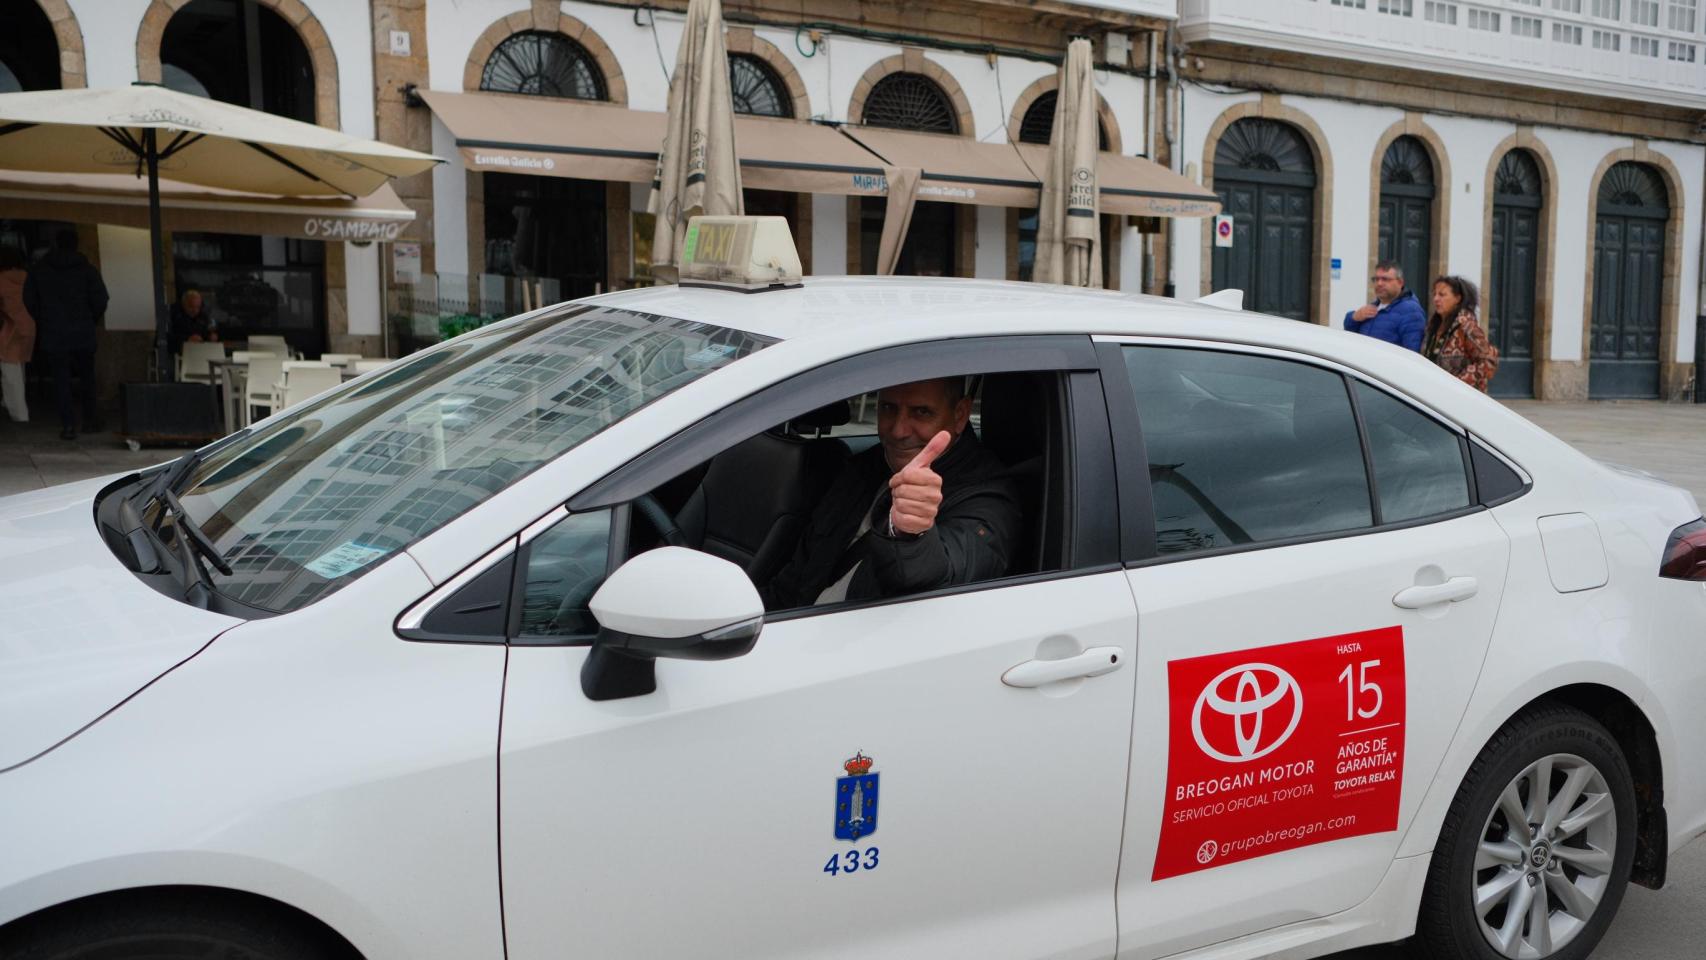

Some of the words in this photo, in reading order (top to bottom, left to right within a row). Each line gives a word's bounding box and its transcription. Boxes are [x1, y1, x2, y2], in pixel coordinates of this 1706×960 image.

[304, 218, 399, 239] O'SAMPAIO
[697, 224, 735, 262] TAXI
[1337, 643, 1362, 655] HASTA
[1338, 659, 1383, 721] 15
[1337, 741, 1370, 760] AÑOS
[1372, 737, 1388, 752] DE
[1175, 771, 1254, 801] BREOGAN
[1259, 759, 1315, 784] MOTOR
[1333, 775, 1367, 791] TOYOTA
[1368, 769, 1396, 784] RELAX
[1172, 802, 1225, 824] SERVICIO
[1227, 793, 1269, 812] OFICIAL
[1272, 783, 1315, 803] TOYOTA
[1220, 814, 1356, 857] grupobreogan.com
[823, 846, 880, 877] 433
